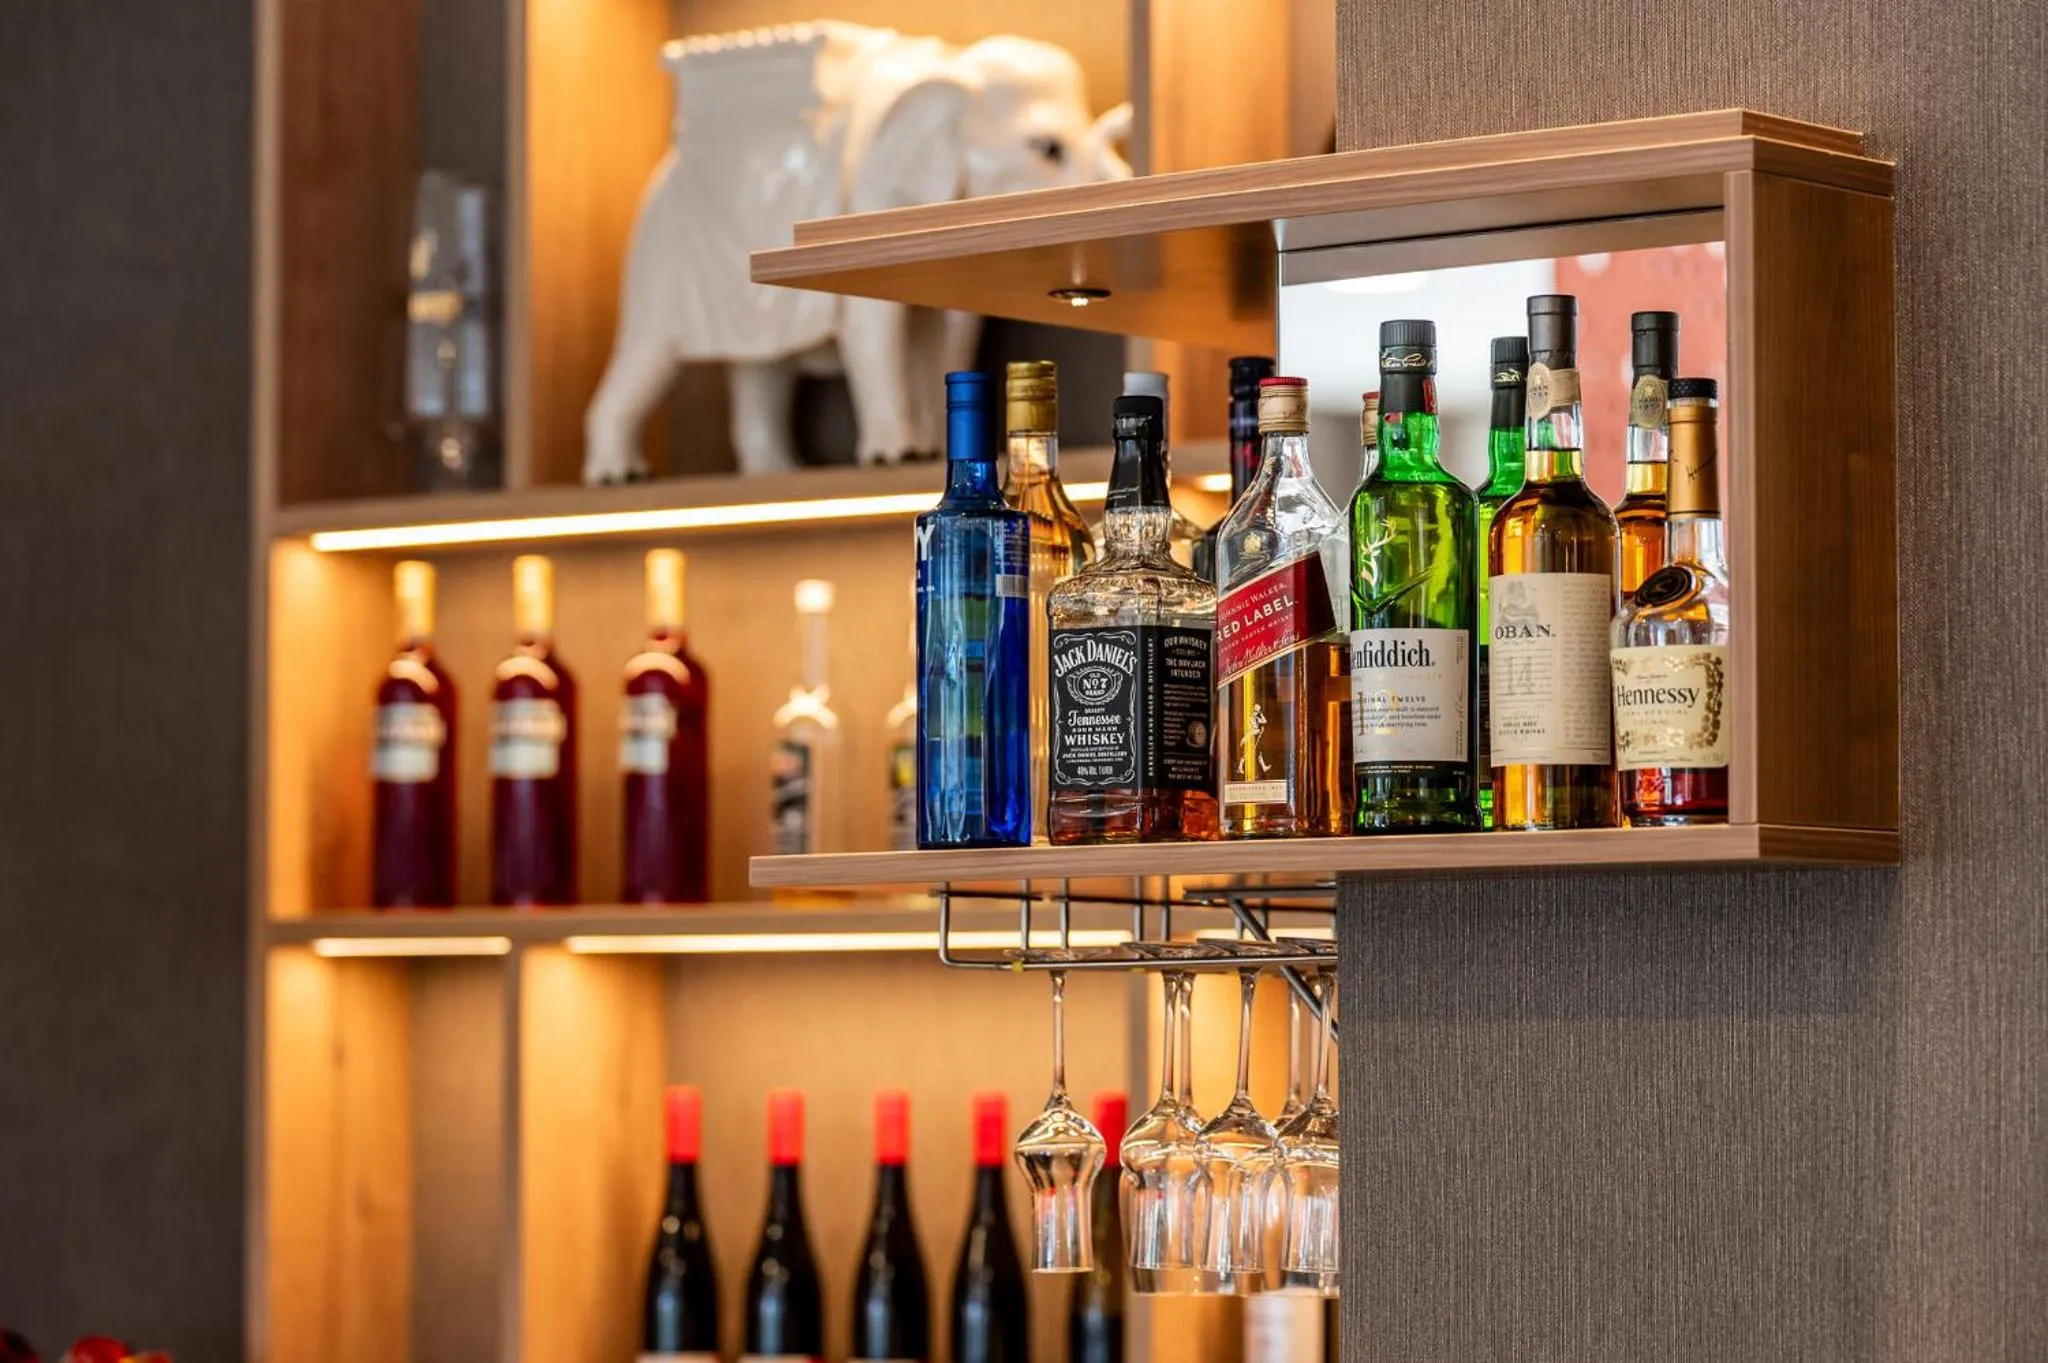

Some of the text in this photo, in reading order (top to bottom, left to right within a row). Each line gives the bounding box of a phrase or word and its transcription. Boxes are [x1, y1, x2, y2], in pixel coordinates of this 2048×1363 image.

[1243, 594, 1294, 627] LABEL
[1495, 623, 1552, 640] OBAN
[1054, 639, 1138, 677] JACK DANIEL'S
[1617, 684, 1700, 709] Hennessy
[1067, 709, 1121, 727] Tennessee
[1064, 732, 1126, 747] WHISKEY
